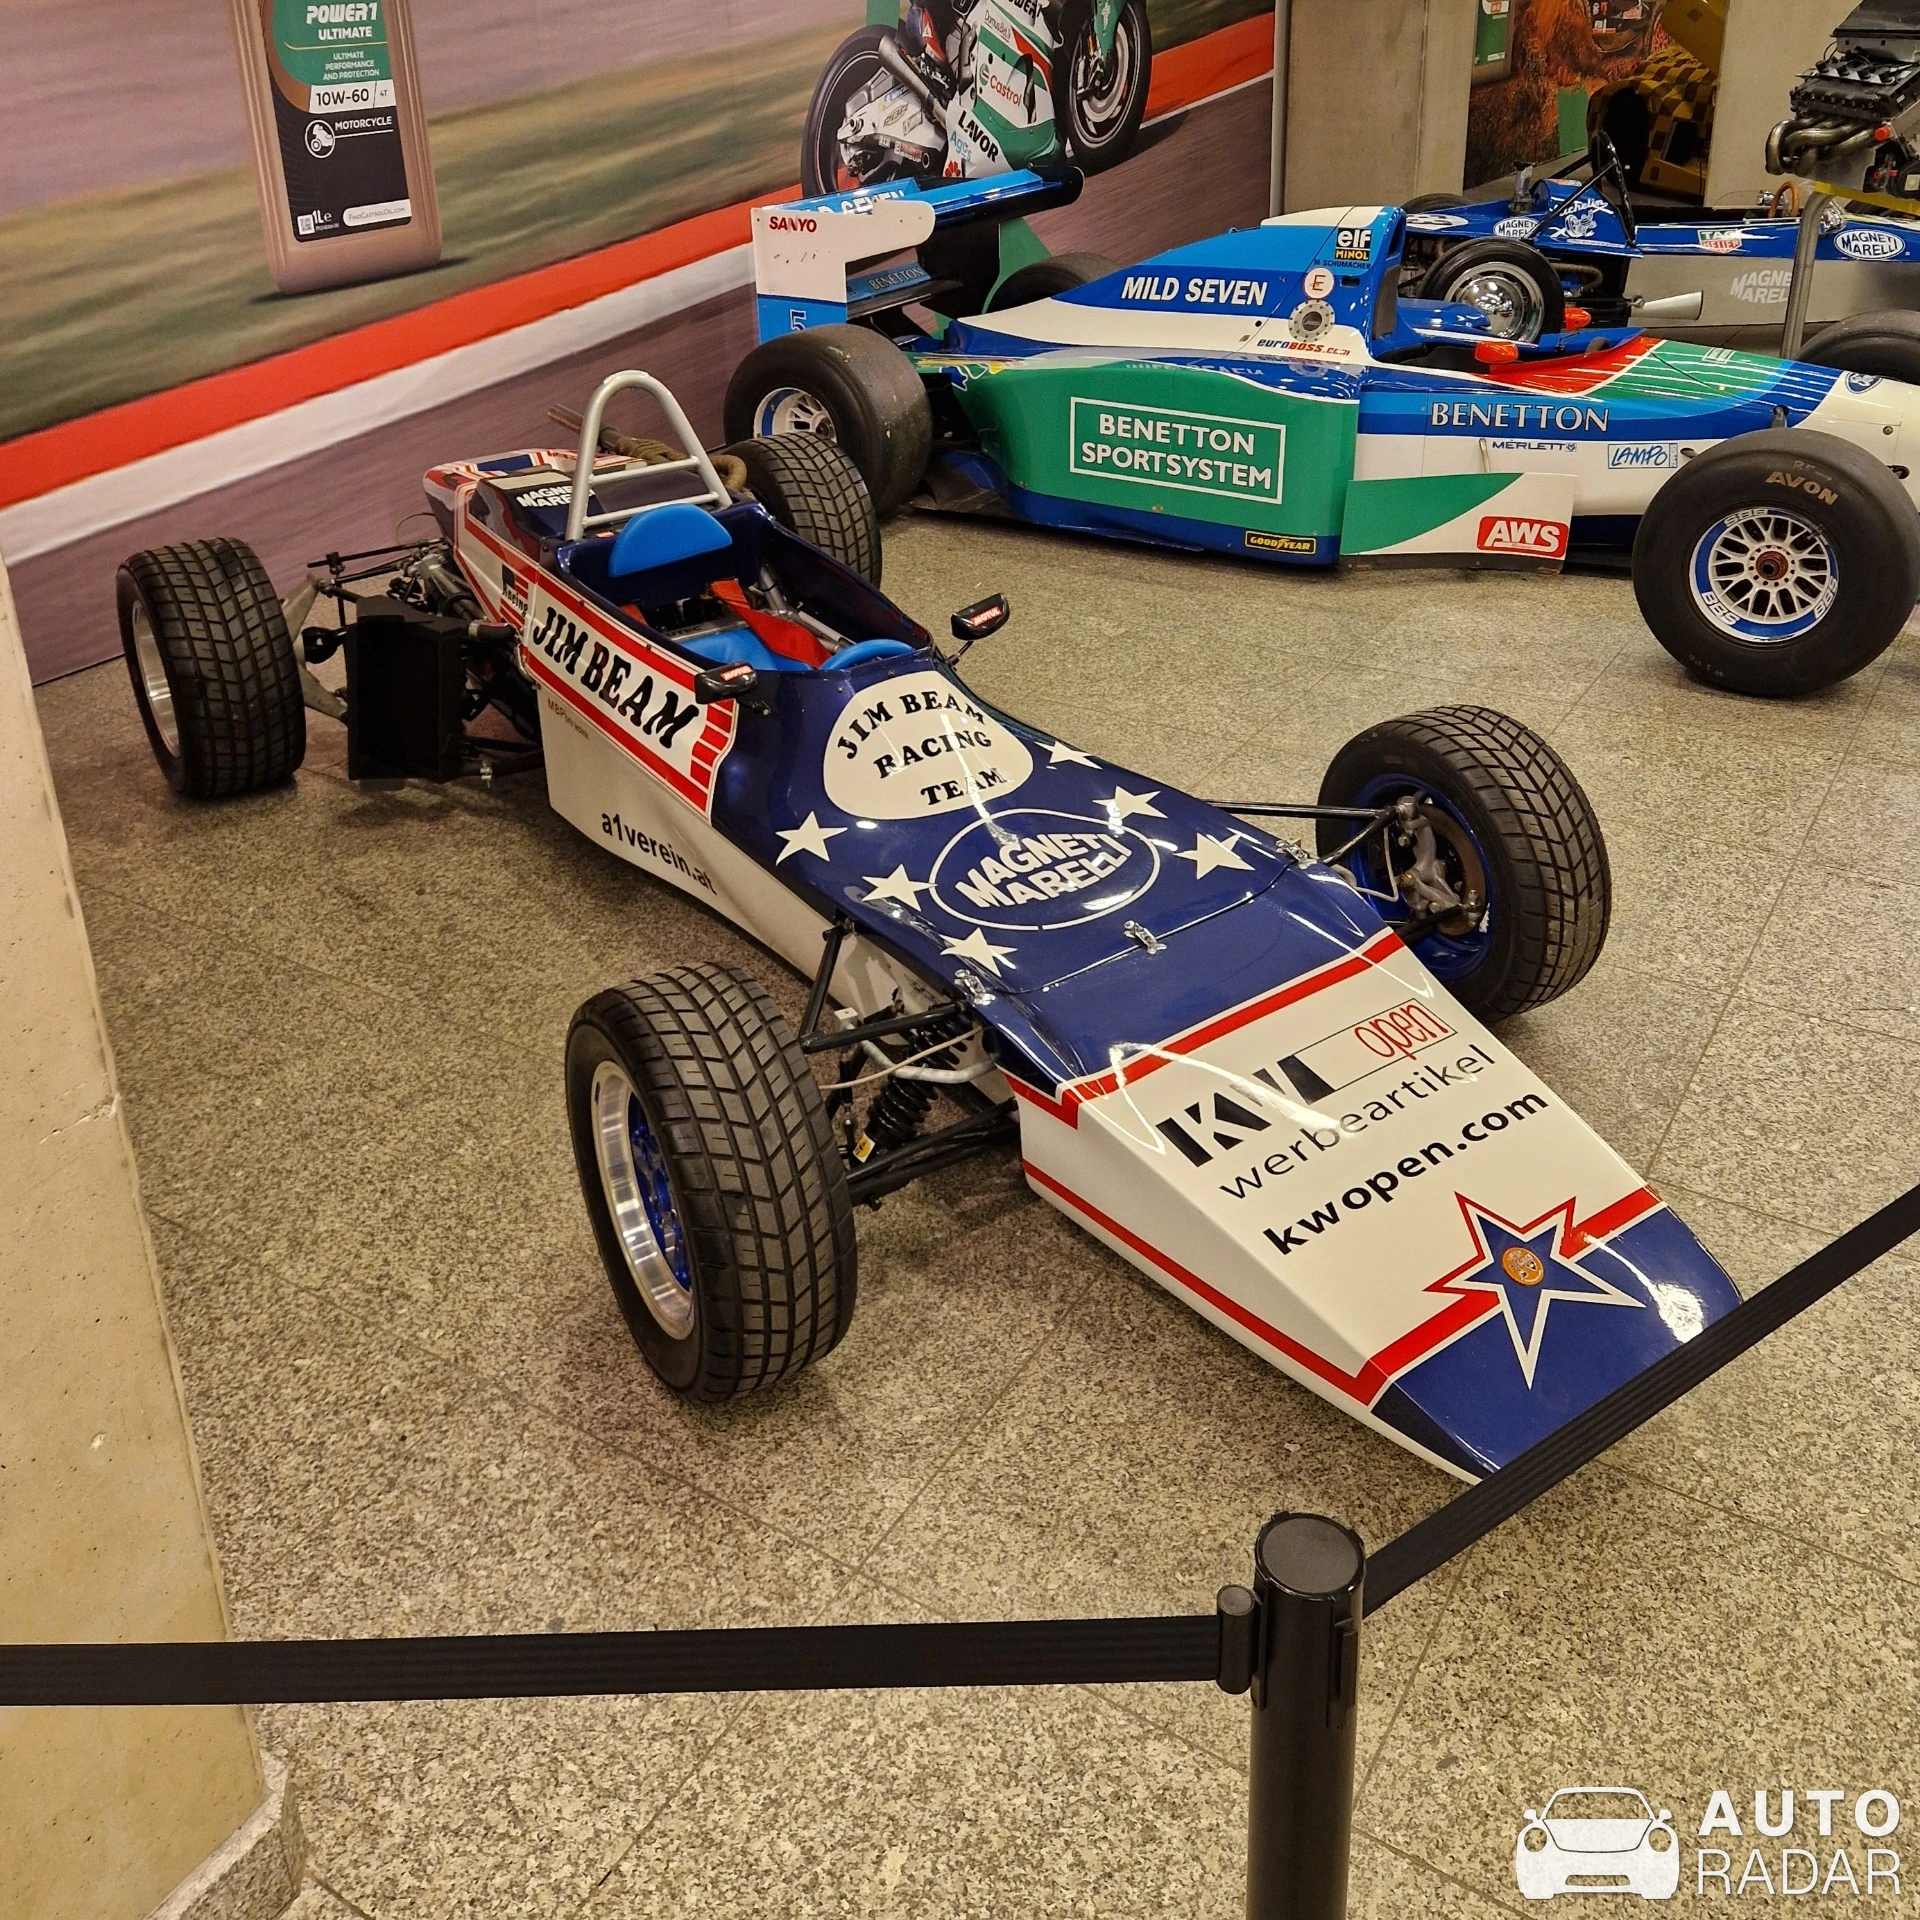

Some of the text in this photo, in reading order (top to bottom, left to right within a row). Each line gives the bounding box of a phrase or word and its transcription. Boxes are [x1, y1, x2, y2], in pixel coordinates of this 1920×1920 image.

[306, 3, 377, 24] POWER1
[318, 26, 373, 40] ULTIMATE
[325, 60, 375, 71] PERFORMANCE
[332, 51, 365, 61] ULTIMATE
[323, 69, 380, 81] AND PROTECTION
[989, 75, 1022, 106] Castrol
[316, 88, 388, 106] 10W-60 4T
[335, 116, 393, 131] MOTORCYCLE
[957, 110, 999, 163] LAVOR
[949, 129, 973, 163] Agos
[769, 215, 818, 233] SANYO
[1337, 229, 1372, 249] elf
[1841, 231, 1899, 247] MAGNETI
[1335, 250, 1369, 260] MINOL
[1842, 240, 1898, 256] MARELLI
[869, 267, 926, 290] BENETTON
[1323, 260, 1371, 269] SCHUMACHER
[1121, 276, 1267, 306] MILD SEVEN
[1311, 274, 1327, 292] E
[790, 309, 806, 331] 5
[1431, 401, 1609, 433] BENETTON
[1098, 413, 1255, 456] BENETTON
[1081, 442, 1272, 490] SPORTSYSTEM
[1610, 445, 1668, 466] LAMPO
[1765, 471, 1839, 506] AVON
[1249, 536, 1311, 551] GOODYEAR
[1483, 519, 1561, 553] AWS
[1701, 591, 1741, 626] BBS
[1813, 576, 1839, 620] BBS
[532, 606, 700, 749] JIM BEAM
[837, 690, 985, 759] JIM BEAM
[873, 730, 992, 779] RACING
[920, 767, 1008, 806] TEAM
[601, 812, 718, 896] a1verein.at
[955, 833, 1132, 900] MAGNETI
[958, 851, 1132, 908] MARELLI
[1354, 1003, 1449, 1061] open
[1219, 1043, 1497, 1200] werbeartikel
[1262, 1092, 1550, 1256] kwopen.com
